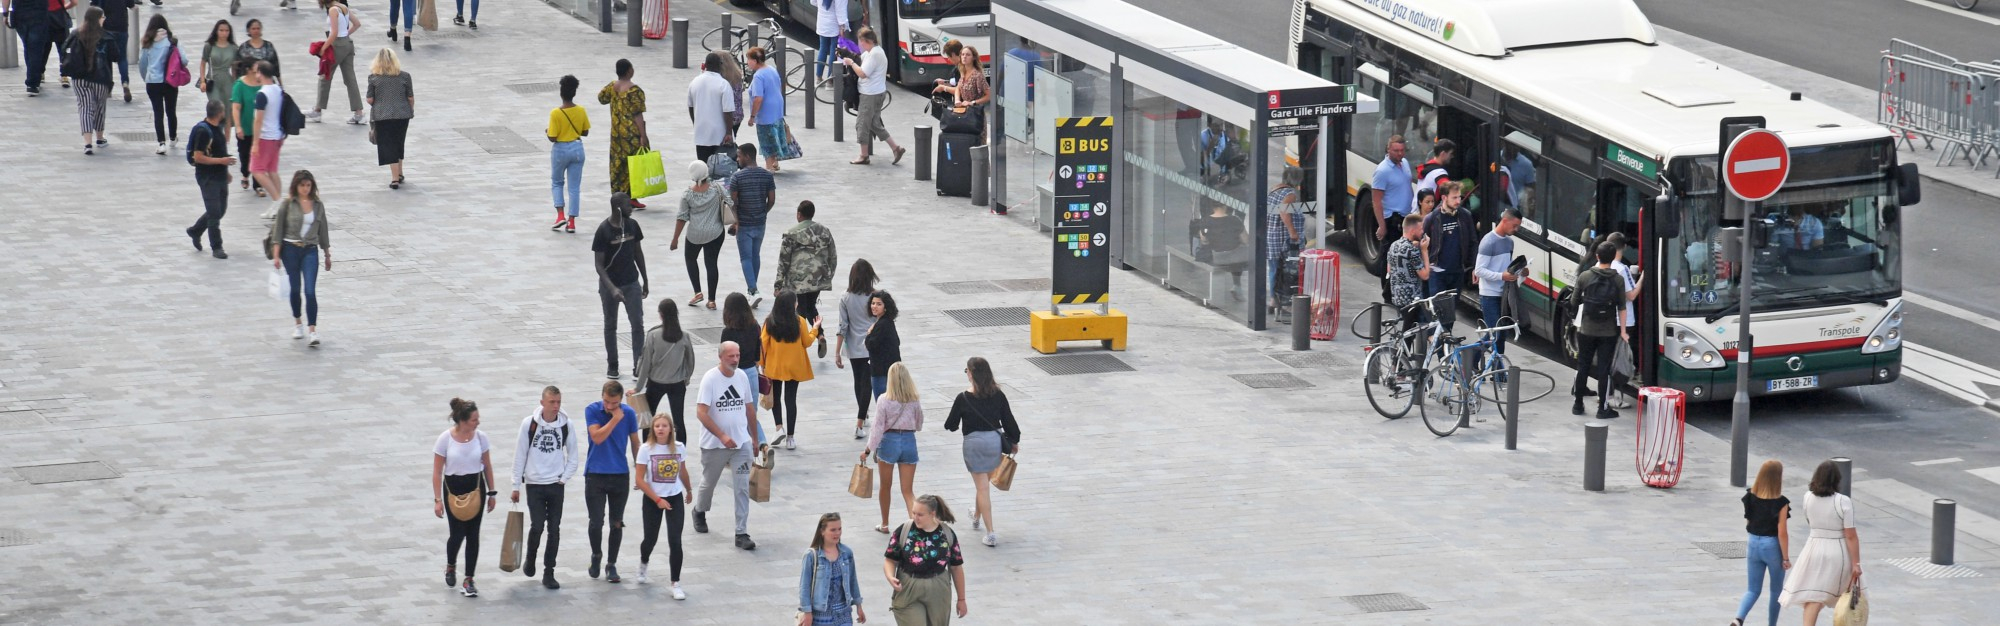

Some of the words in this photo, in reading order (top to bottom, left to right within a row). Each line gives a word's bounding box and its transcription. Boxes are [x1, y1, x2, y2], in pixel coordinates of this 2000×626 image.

[1391, 3, 1407, 20] gaz
[1346, 86, 1354, 102] 10
[1271, 109, 1292, 118] Gare
[1294, 107, 1313, 117] Lille
[1315, 105, 1353, 115] Flandres
[1079, 138, 1109, 152] BUS
[1617, 149, 1644, 172] Bienvenue
[1691, 274, 1708, 286] 02
[1819, 325, 1861, 337] Transpole
[715, 399, 744, 408] adidas
